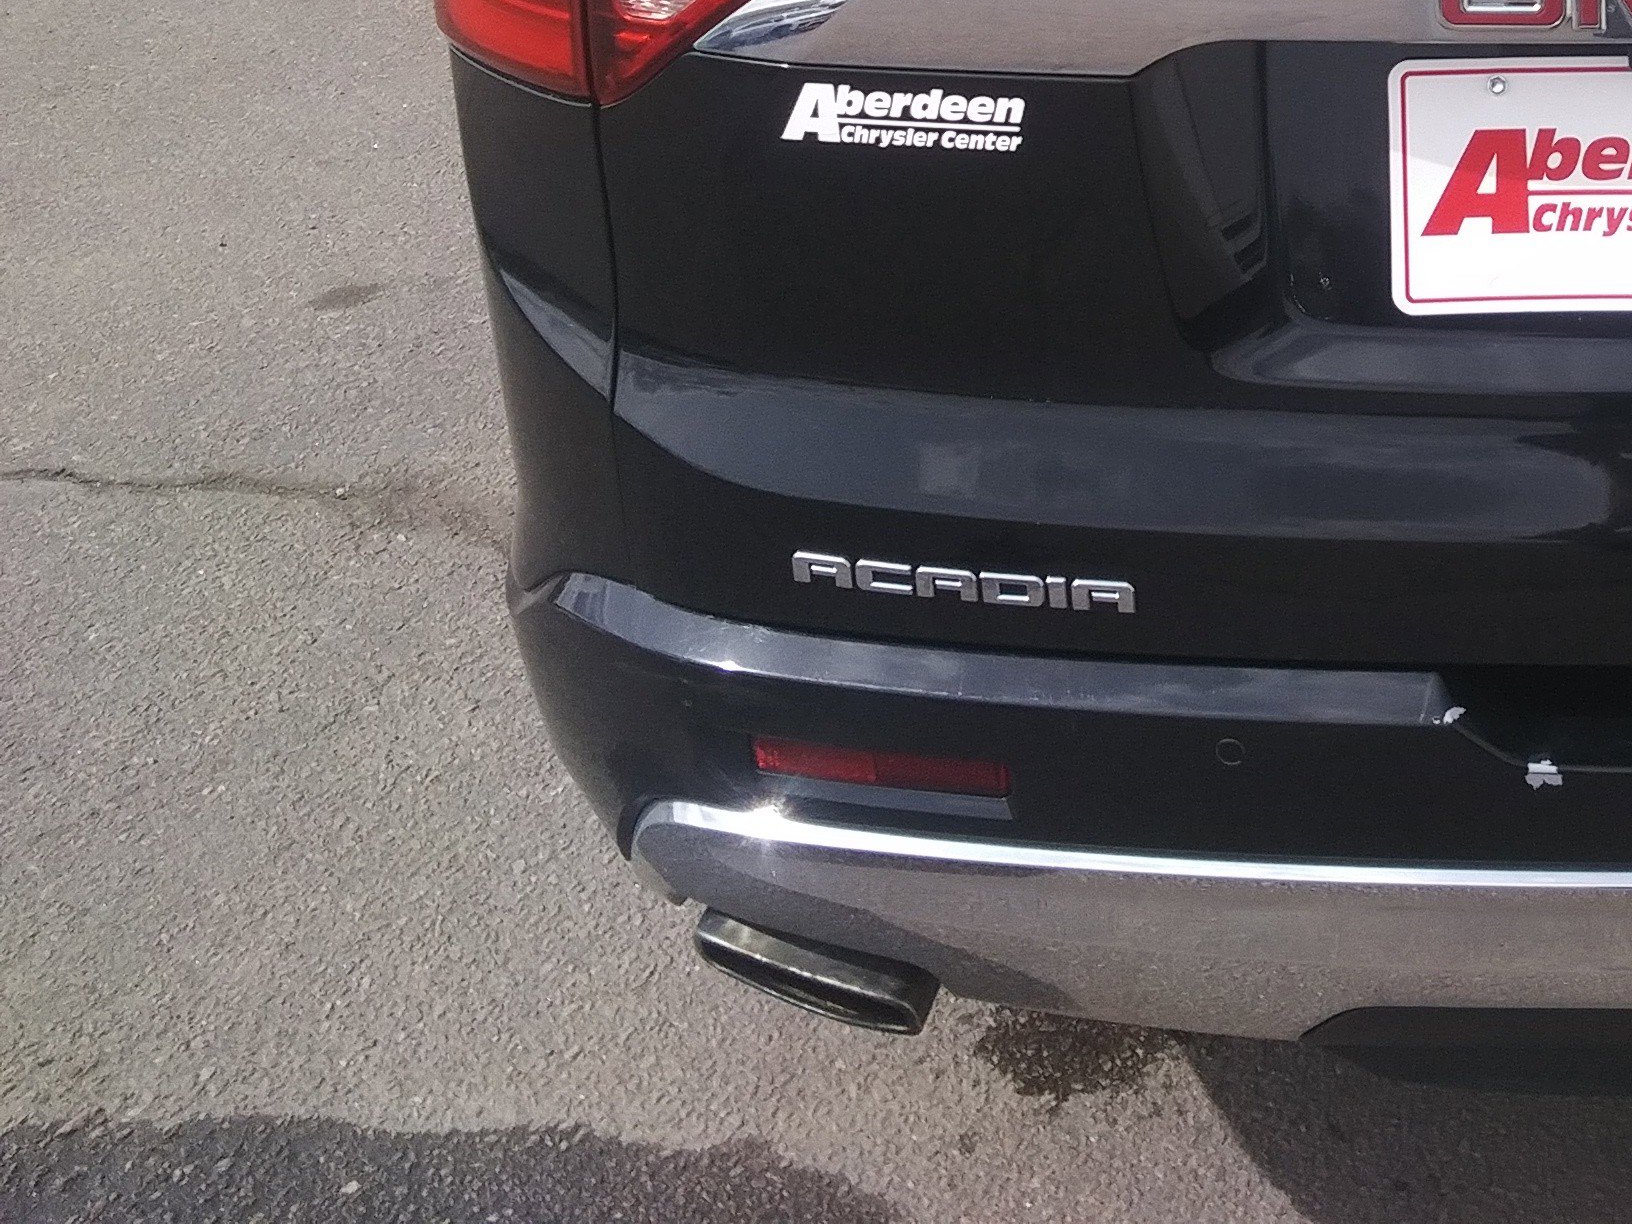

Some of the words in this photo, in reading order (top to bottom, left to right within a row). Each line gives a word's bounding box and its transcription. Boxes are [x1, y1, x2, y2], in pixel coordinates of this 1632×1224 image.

[781, 82, 1026, 143] Aberdeen
[840, 125, 939, 148] Chrysler
[940, 130, 1023, 152] Center
[792, 550, 1136, 614] ACADIA
